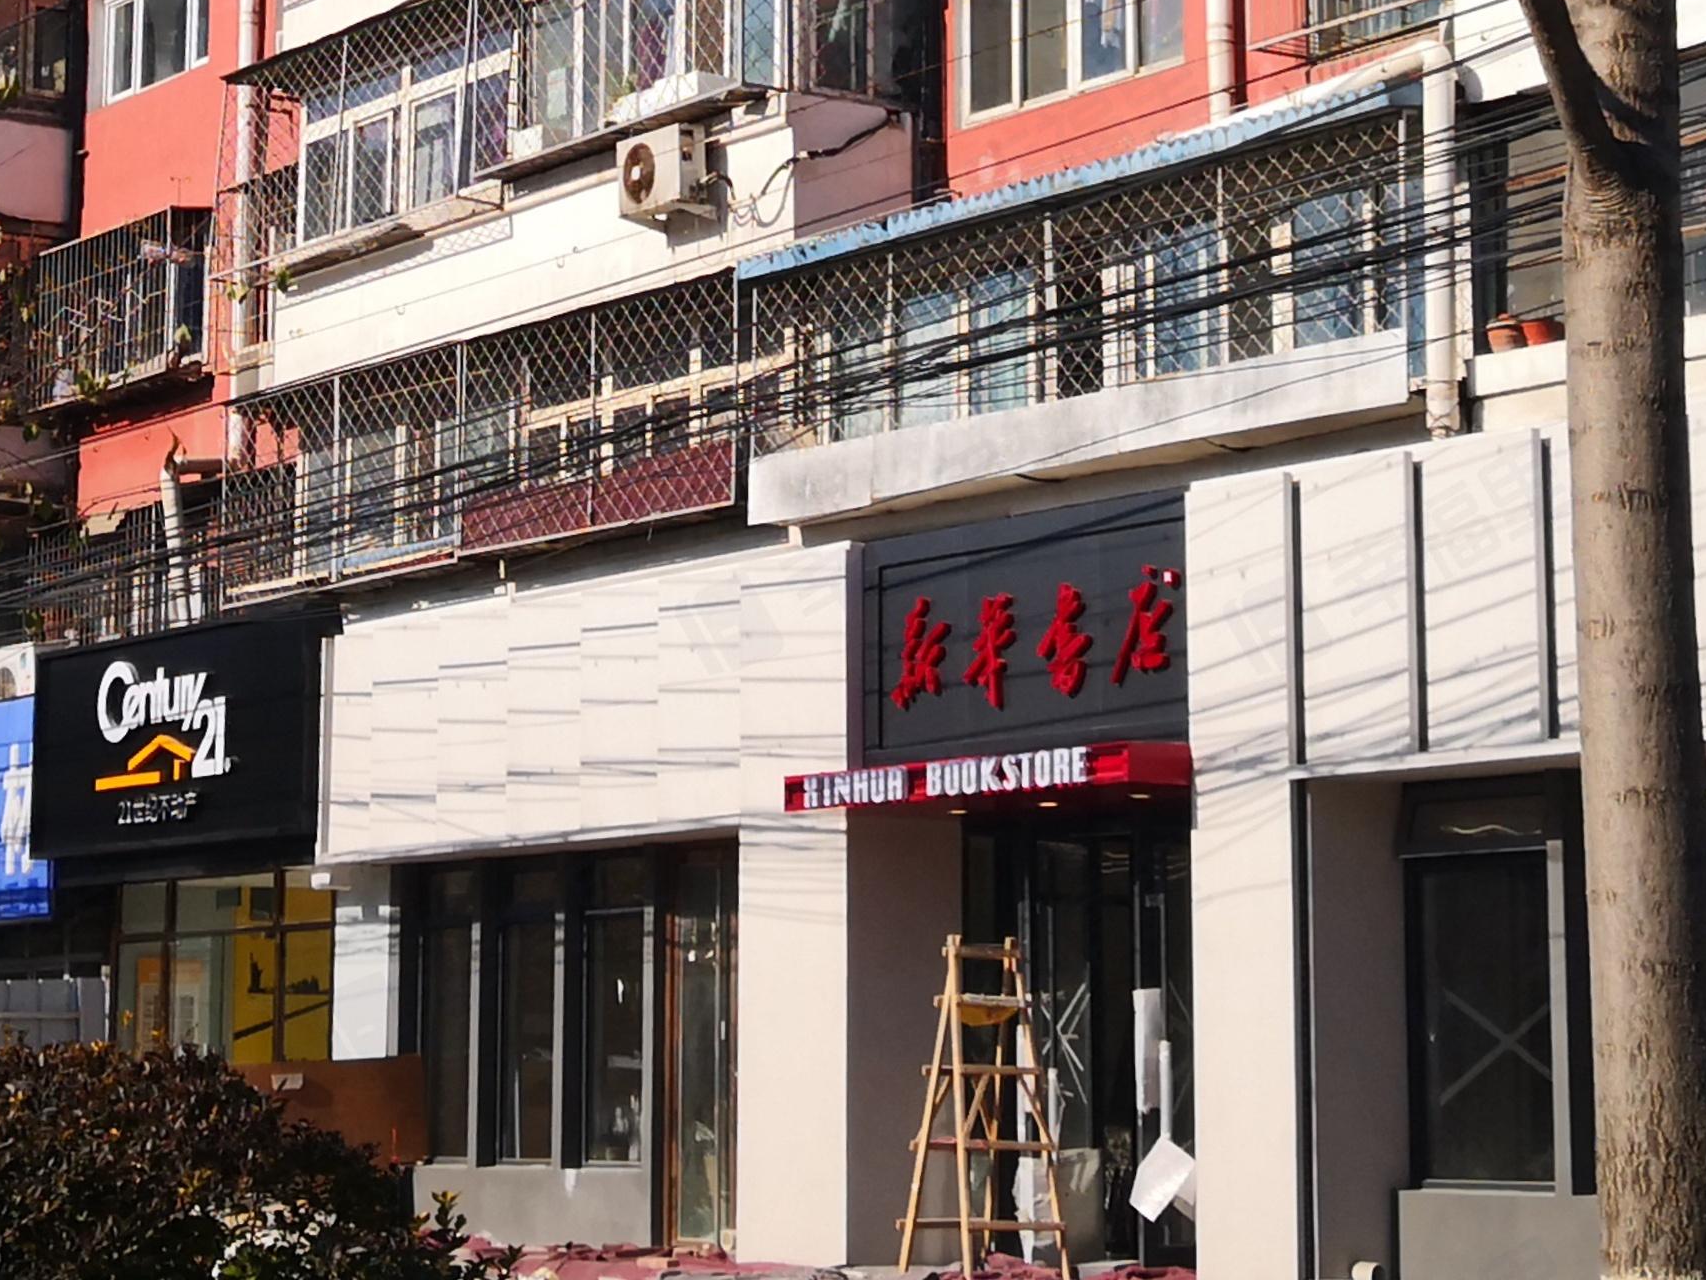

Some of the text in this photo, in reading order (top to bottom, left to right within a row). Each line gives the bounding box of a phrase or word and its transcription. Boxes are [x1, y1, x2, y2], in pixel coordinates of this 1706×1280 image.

[190, 695, 226, 779] 21
[925, 745, 1090, 798] BOOKSTORE
[117, 791, 197, 826] 21世纪不动产
